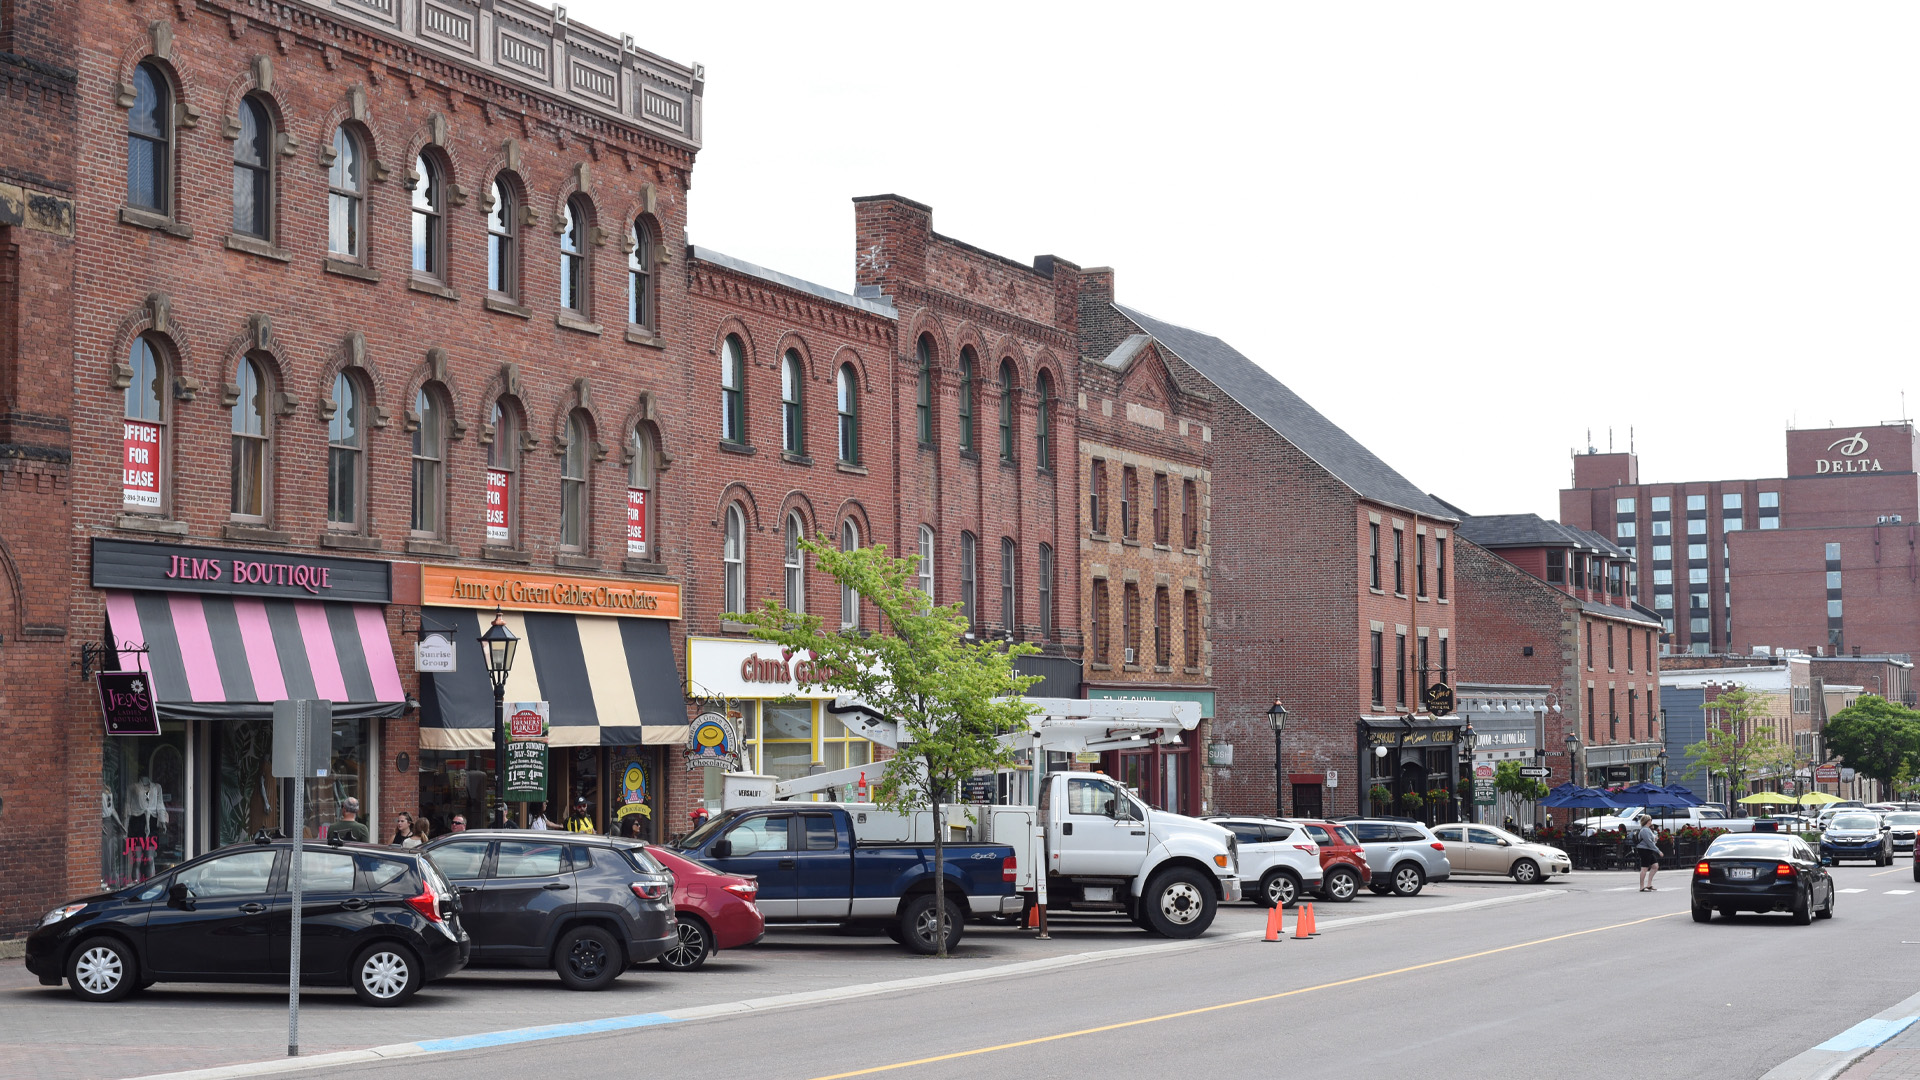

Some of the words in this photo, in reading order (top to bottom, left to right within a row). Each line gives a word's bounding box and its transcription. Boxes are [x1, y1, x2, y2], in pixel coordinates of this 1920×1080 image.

[128, 447, 149, 465] FOR
[1815, 458, 1884, 474] DELTA
[123, 468, 154, 487] LEASE
[487, 472, 506, 487] FFICE
[487, 509, 504, 524] EASE
[165, 555, 222, 581] JEMS
[233, 560, 333, 594] BOUTIQUE
[451, 575, 490, 600] Anne
[494, 579, 508, 601] of
[511, 581, 551, 604] Green
[552, 582, 593, 606] Gables
[595, 586, 658, 610] Chocolates
[419, 650, 451, 658] Sunrise
[422, 659, 449, 667] Group
[508, 742, 525, 751] EVERY
[526, 742, 545, 751] SUNDAY
[692, 759, 730, 769] Chocolates
[738, 789, 762, 797] VERSALIFT
[122, 836, 158, 855] JEMS
